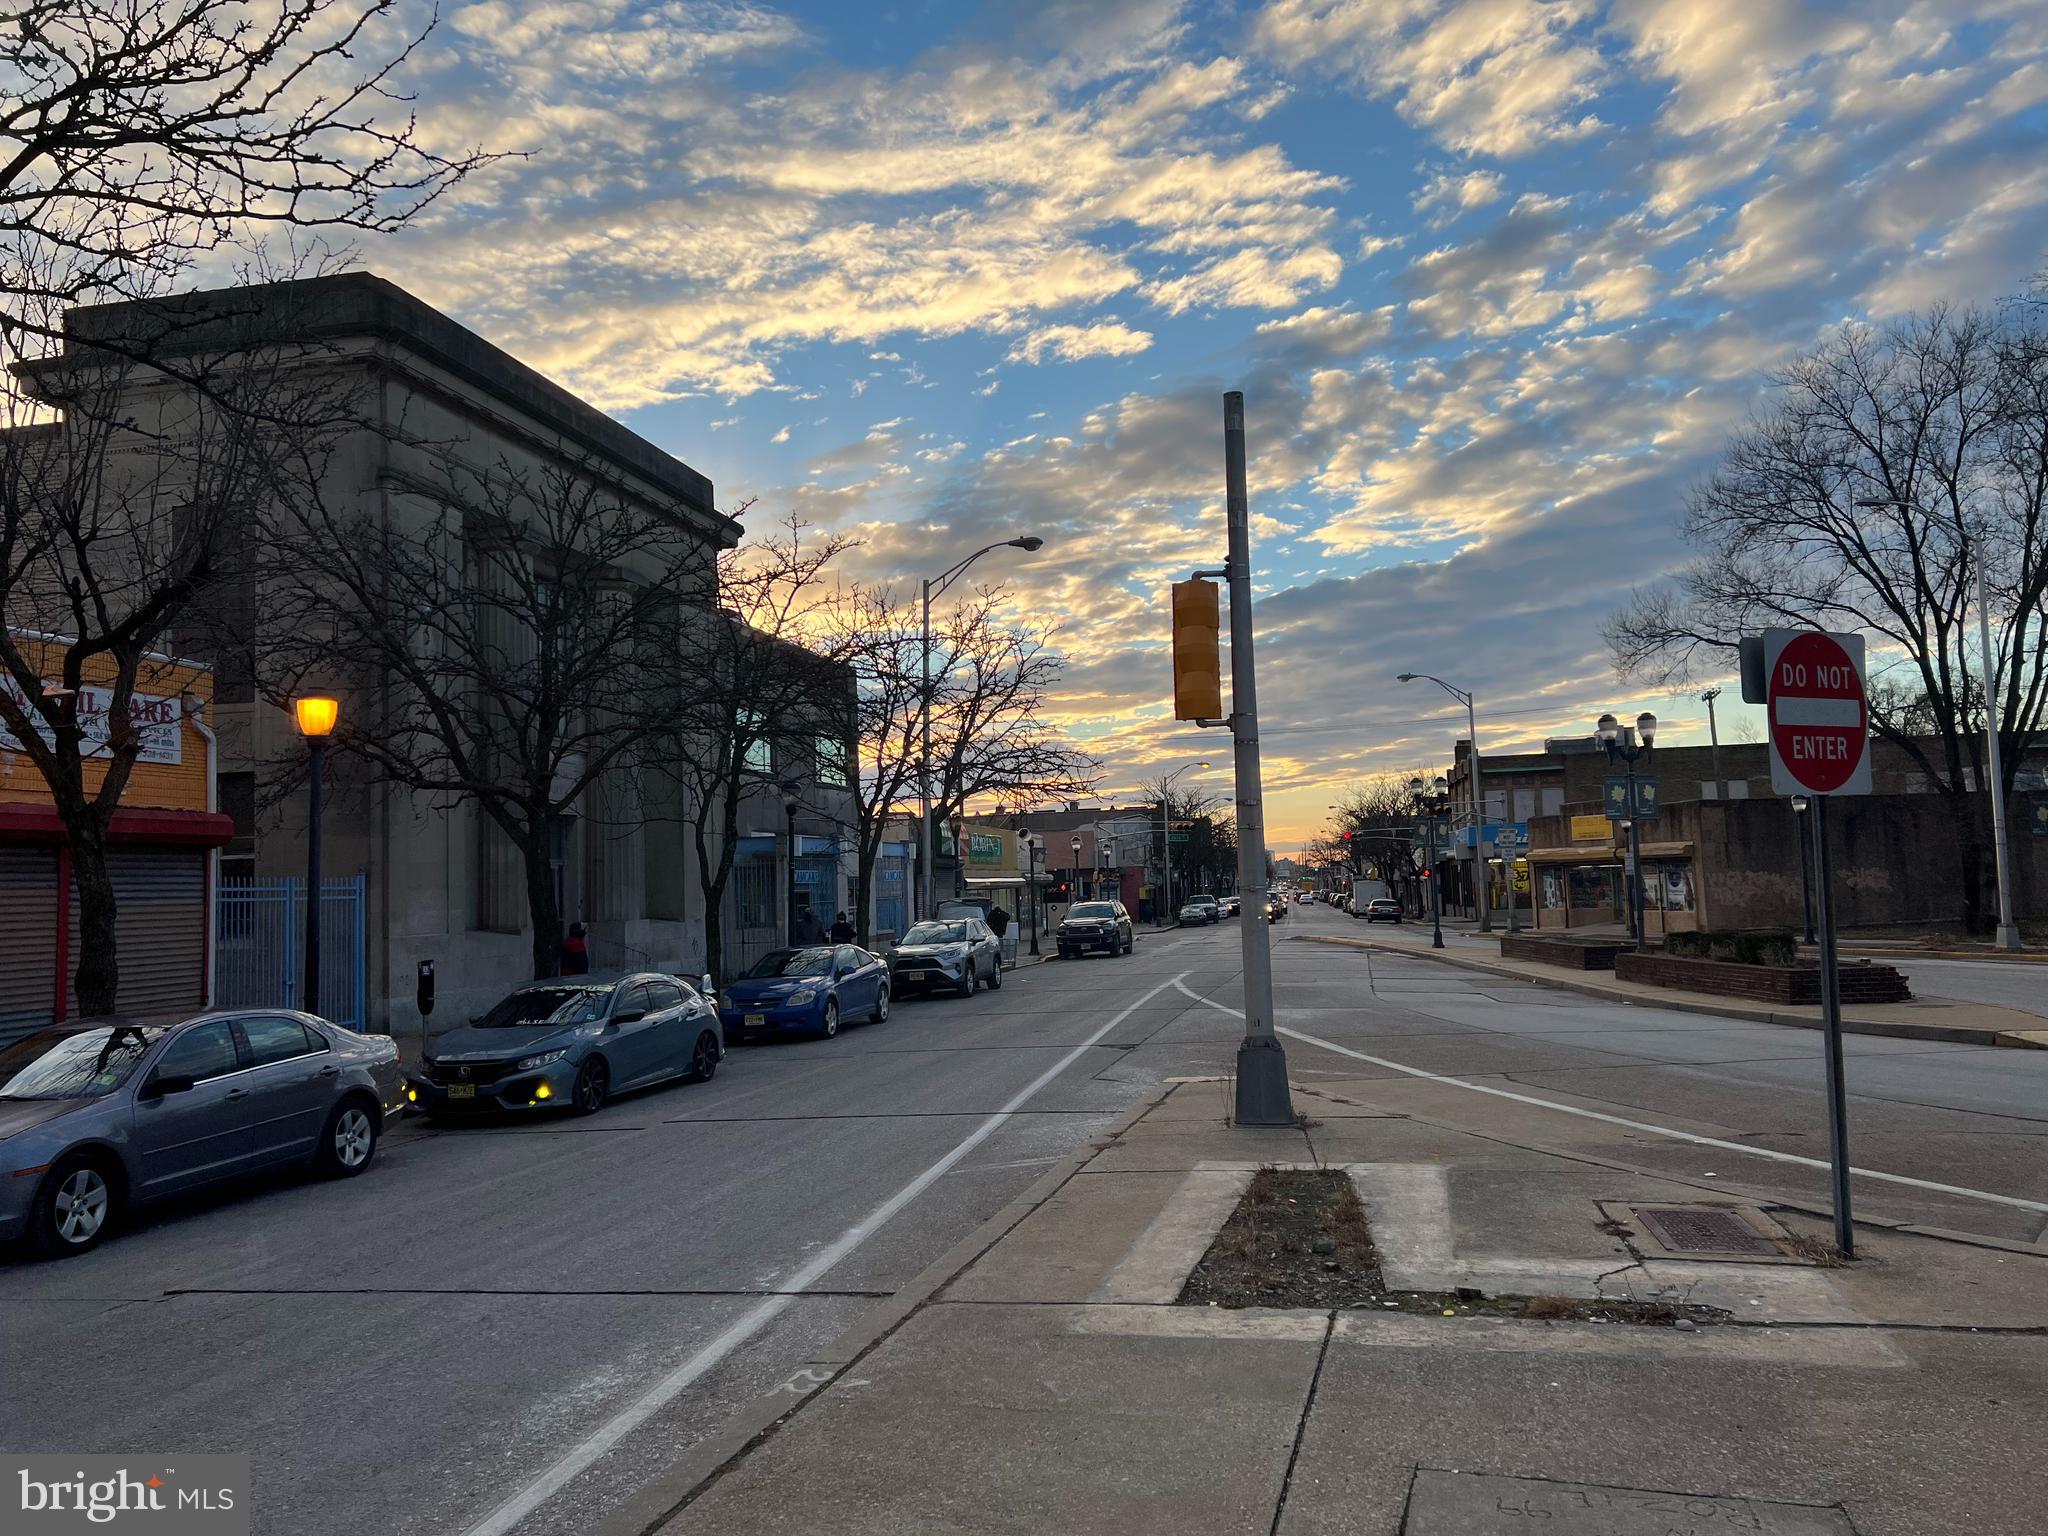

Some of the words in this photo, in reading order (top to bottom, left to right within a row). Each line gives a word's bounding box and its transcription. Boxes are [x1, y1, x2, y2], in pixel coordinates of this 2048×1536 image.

[1782, 663, 1806, 687] DO
[1817, 665, 1850, 690] NOT
[127, 698, 173, 723] ARE
[1792, 735, 1848, 760] ENTER
